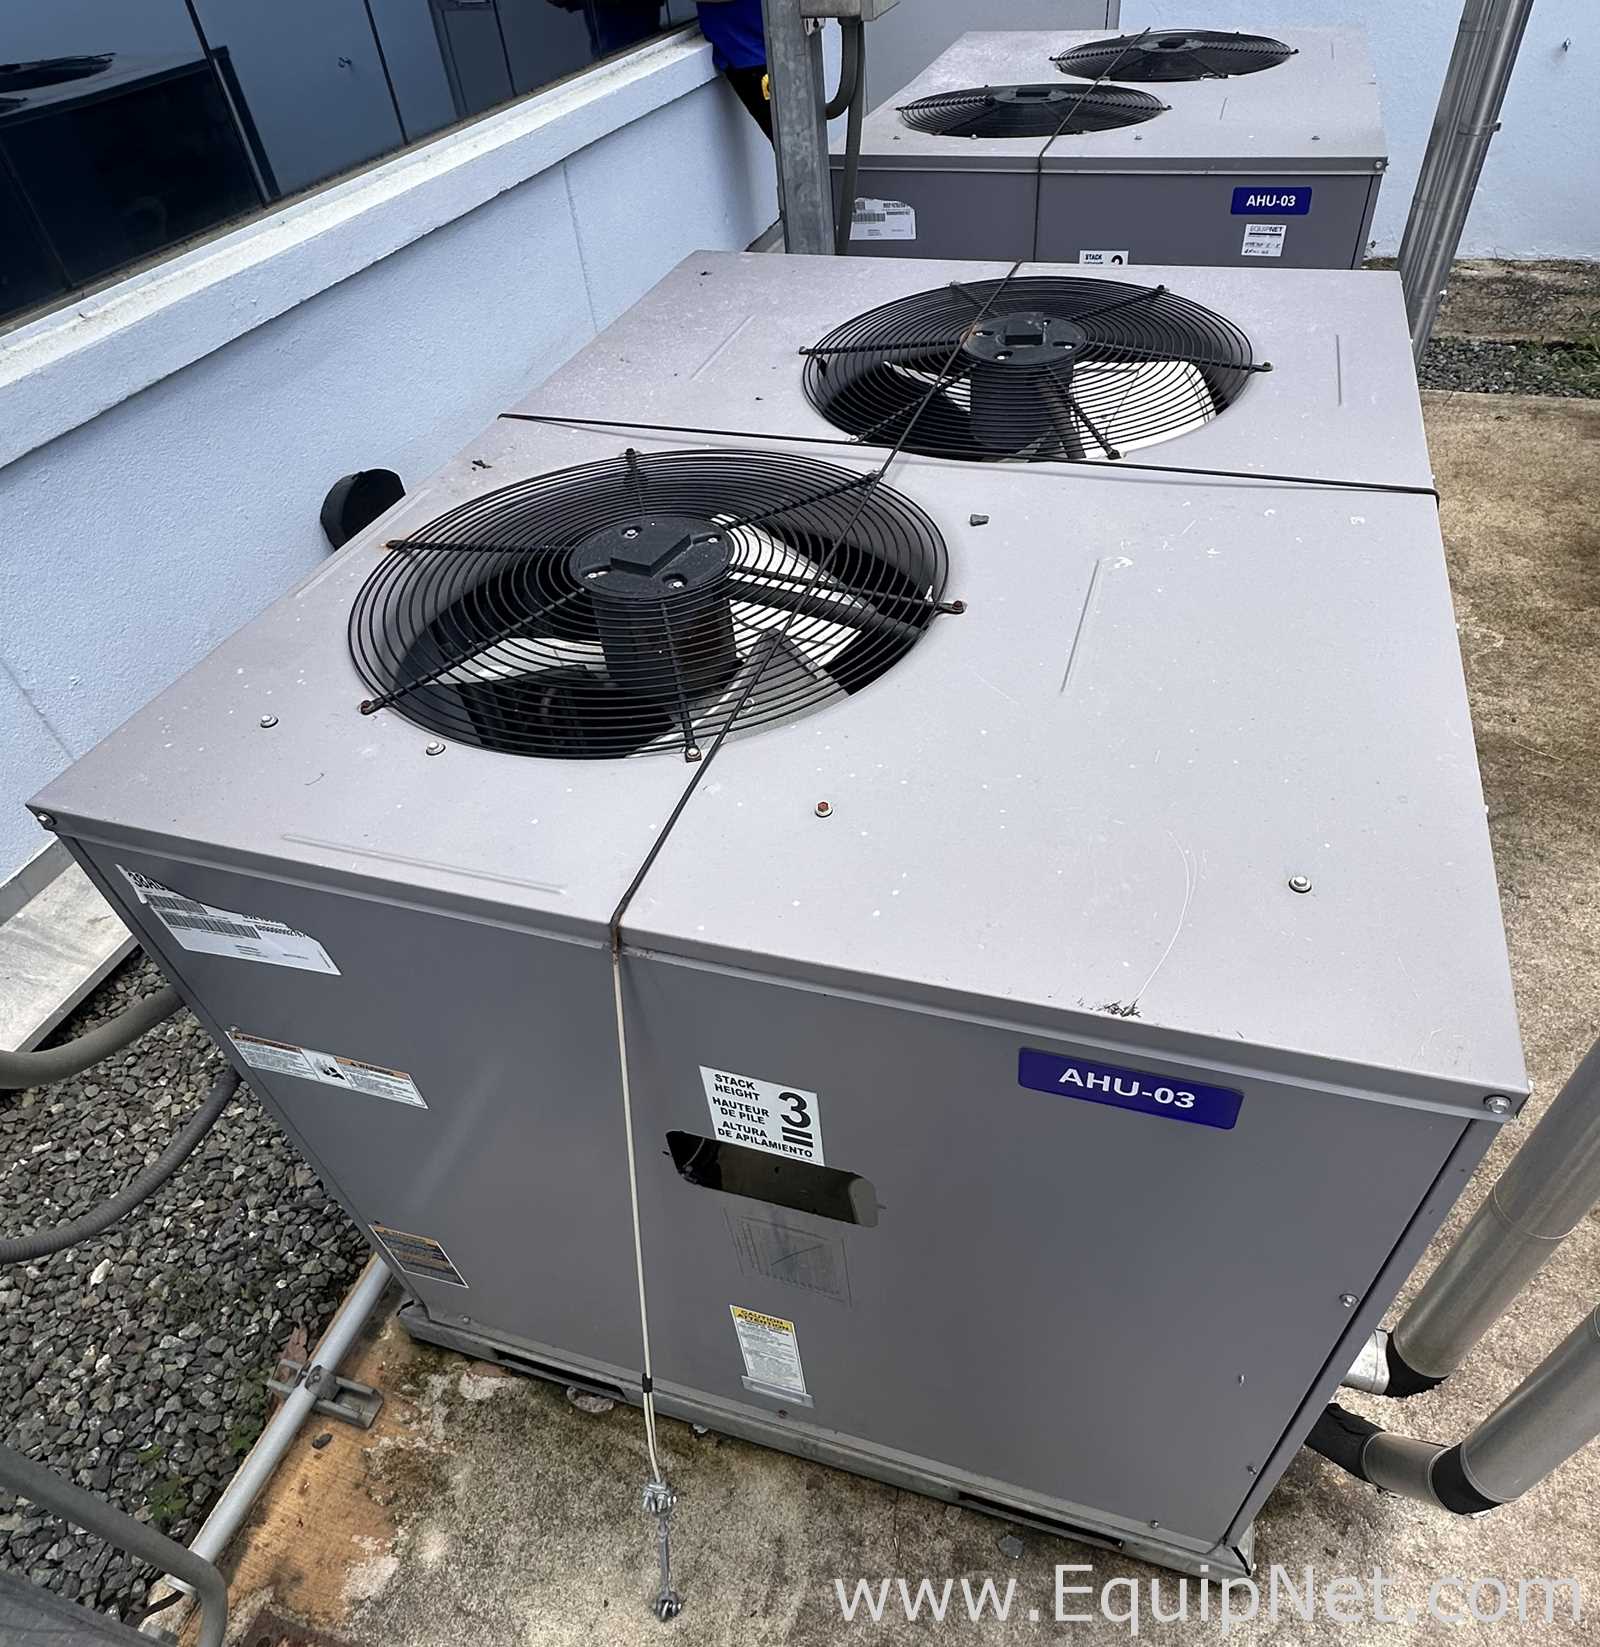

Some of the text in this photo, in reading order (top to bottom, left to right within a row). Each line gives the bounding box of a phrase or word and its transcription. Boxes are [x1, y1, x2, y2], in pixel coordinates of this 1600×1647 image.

[1246, 194, 1296, 207] AHU-03
[714, 1073, 756, 1091] STACK
[1058, 1068, 1196, 1109] AHU-03
[714, 1083, 760, 1101] HEIGHT
[712, 1096, 770, 1117] HAUTEUR
[778, 1091, 811, 1129] 3
[720, 1107, 766, 1125] DE PILE
[722, 1120, 768, 1138] ALTURA
[718, 1128, 813, 1158] DE APILAMIENTO
